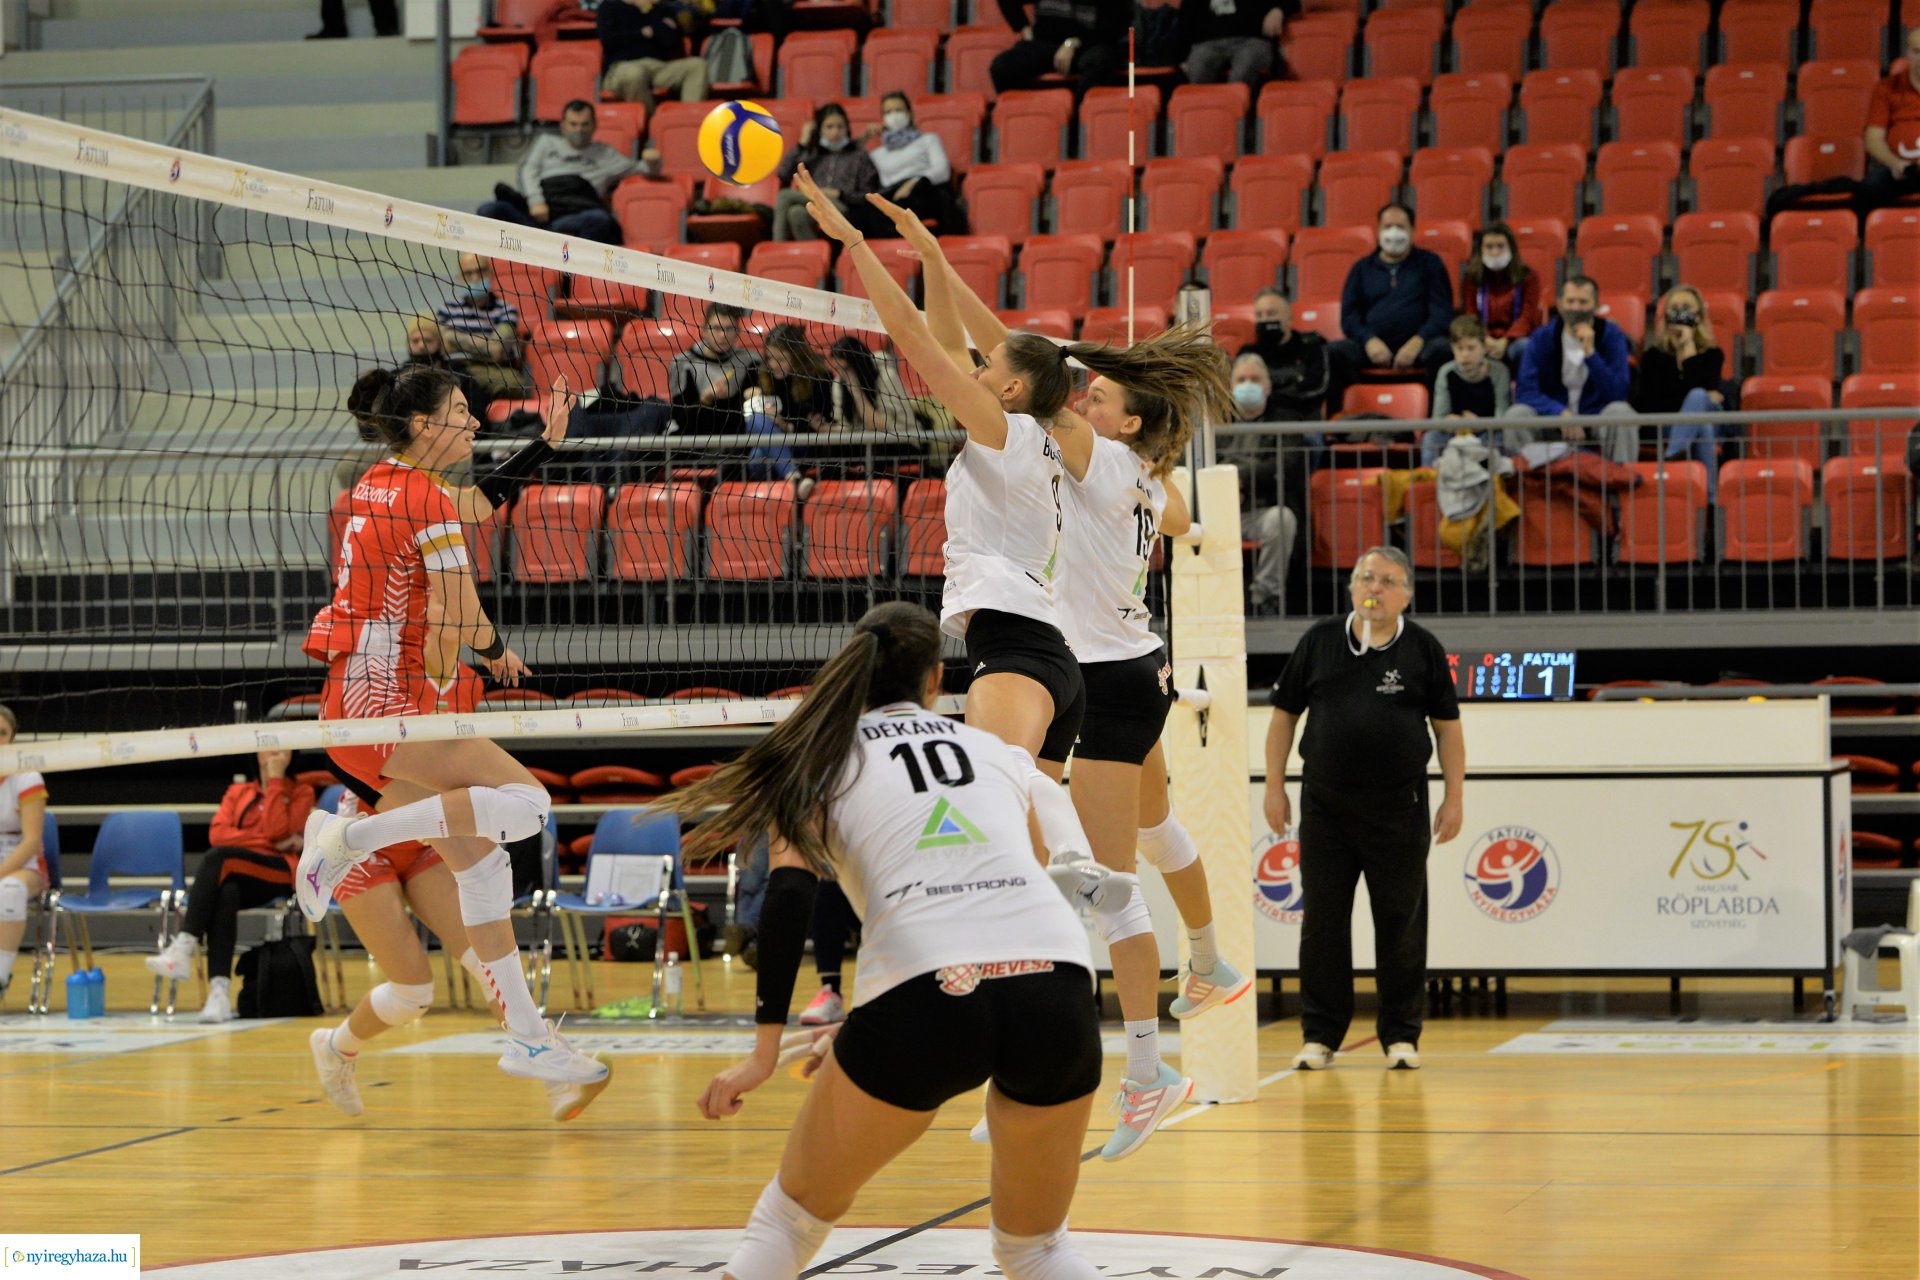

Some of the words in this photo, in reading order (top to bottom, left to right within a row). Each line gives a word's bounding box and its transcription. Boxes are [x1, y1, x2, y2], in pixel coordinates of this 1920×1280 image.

[338, 515, 367, 591] 5
[1523, 652, 1574, 666] FATUM
[1538, 666, 1553, 697] 1
[862, 719, 957, 740] DÉKÁNY
[889, 739, 975, 793] 10
[1488, 826, 1535, 843] FATUM
[1669, 819, 1736, 880] 75
[925, 876, 1027, 896] BESTRONG
[1657, 892, 1780, 915] RÖPLABDA
